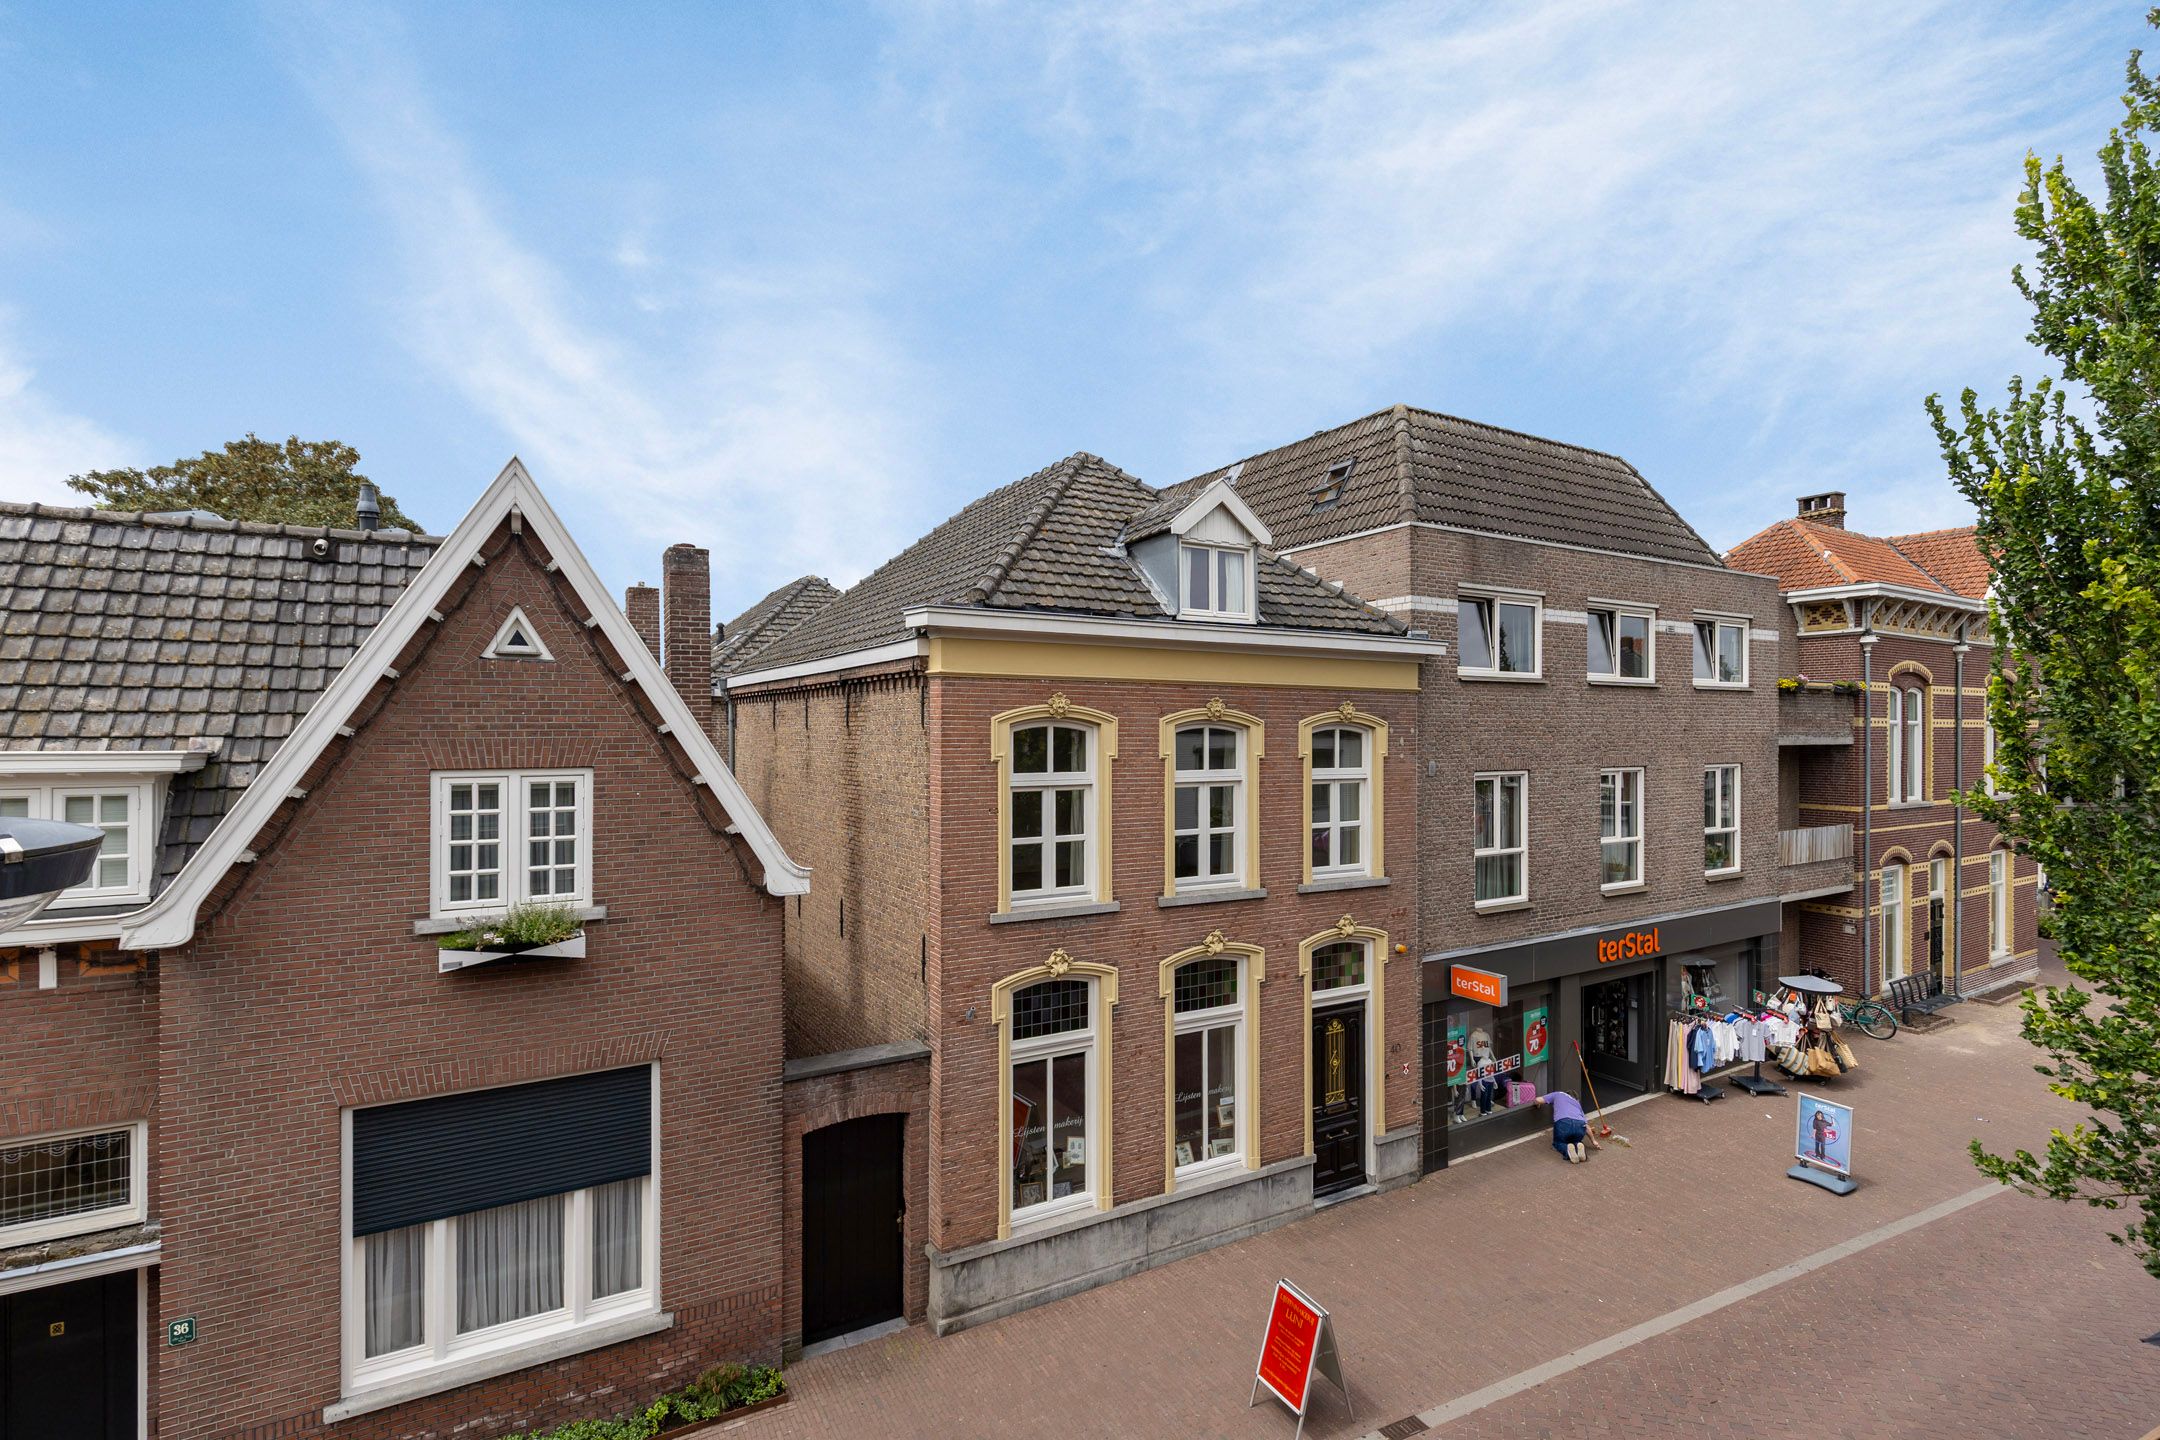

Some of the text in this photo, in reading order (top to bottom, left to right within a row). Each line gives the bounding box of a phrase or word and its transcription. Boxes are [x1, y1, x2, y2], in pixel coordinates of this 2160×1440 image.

[1598, 927, 1661, 963] terStal
[1456, 977, 1495, 996] terStal
[1529, 1039, 1539, 1052] 70
[1467, 1068, 1485, 1083] SALE
[1485, 1060, 1503, 1076] SALE
[1503, 1054, 1520, 1070] SALE
[1175, 1091, 1202, 1103] Lijsten
[1014, 1115, 1084, 1138] Lijsten makerij
[173, 1322, 190, 1336] 36
